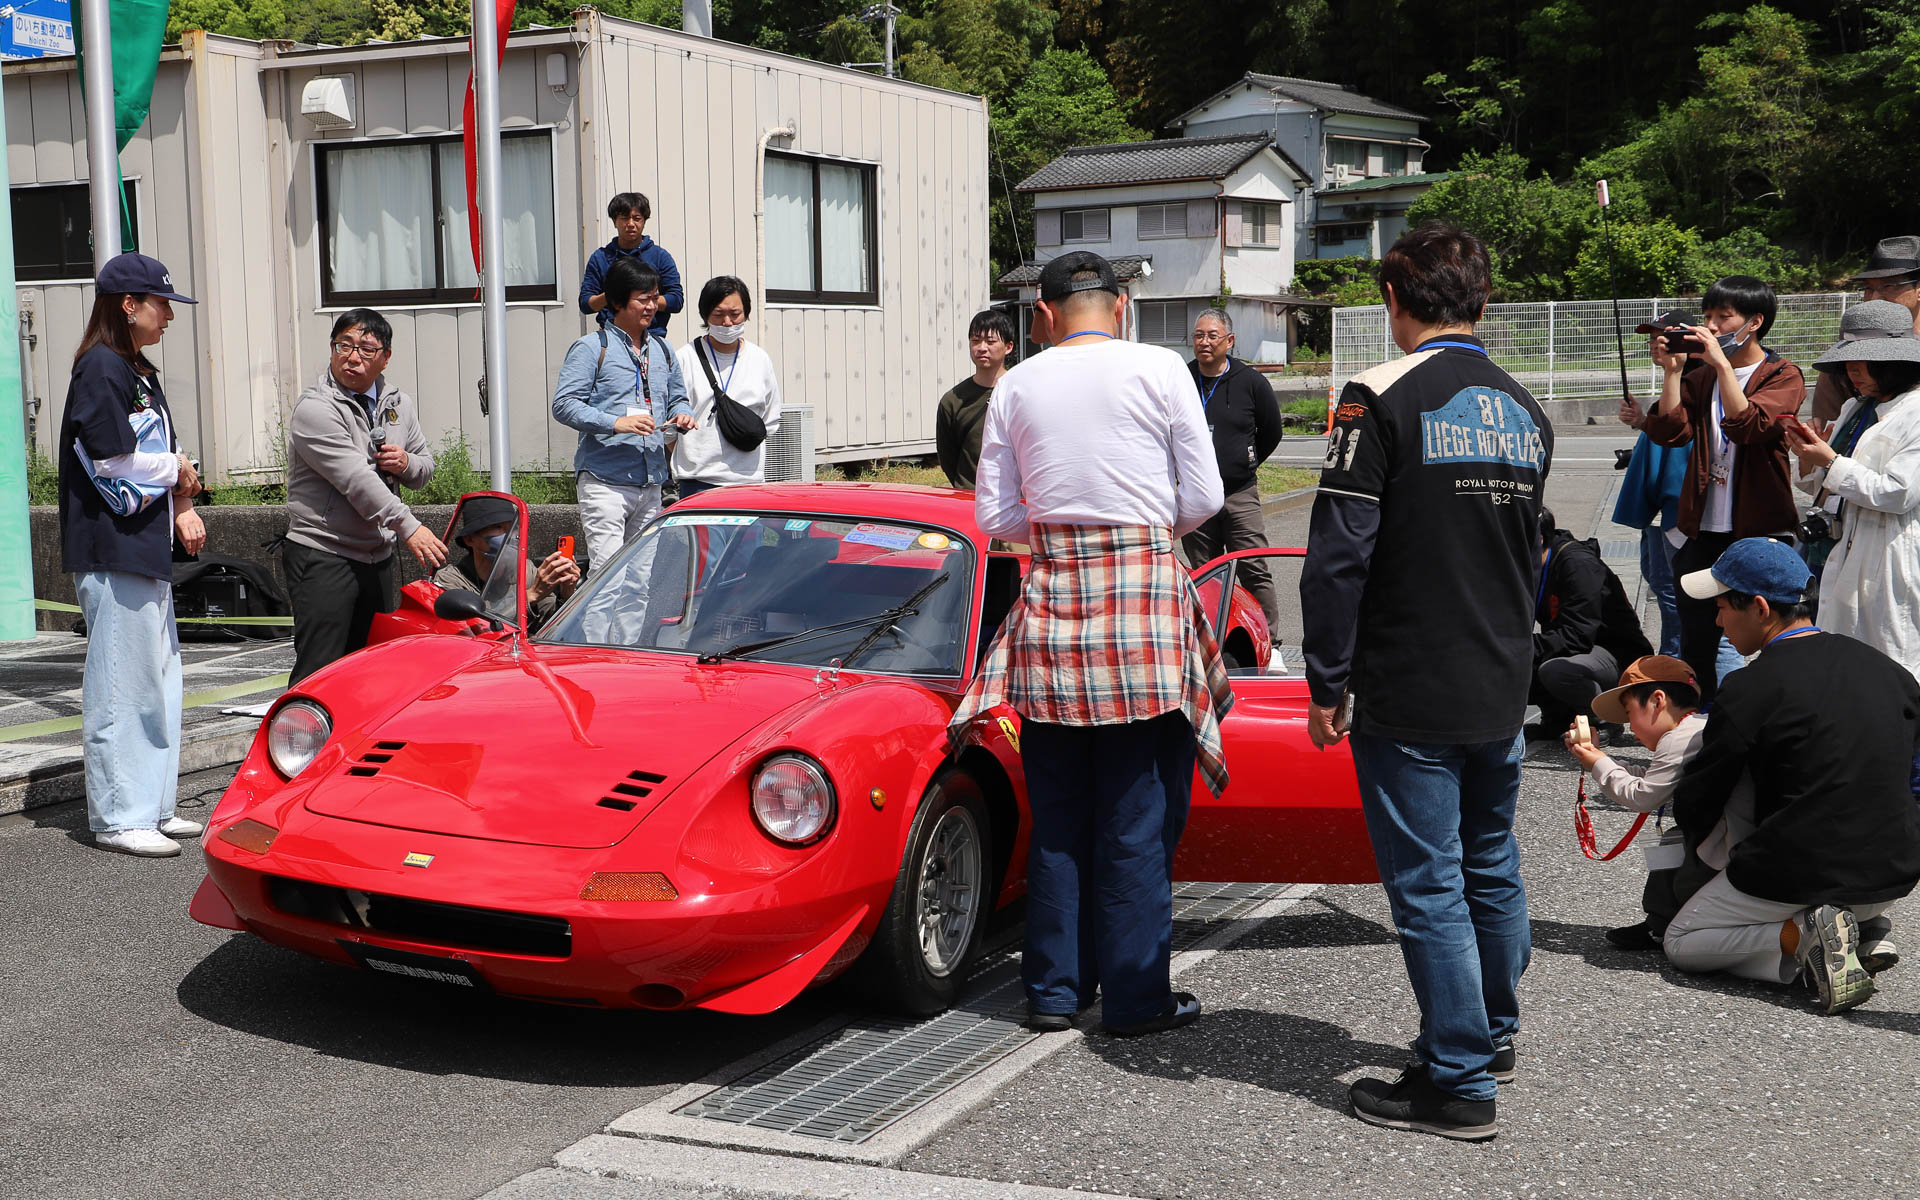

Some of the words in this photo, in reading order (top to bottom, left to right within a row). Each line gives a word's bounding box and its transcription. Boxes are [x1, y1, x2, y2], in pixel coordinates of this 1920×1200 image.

[15, 17, 72, 40] のいち動物公園
[28, 35, 47, 46] Noichi
[49, 39, 60, 48] Zoo
[1477, 394, 1504, 428] 81
[1323, 426, 1361, 471] 81
[1455, 479, 1486, 488] ROYAL
